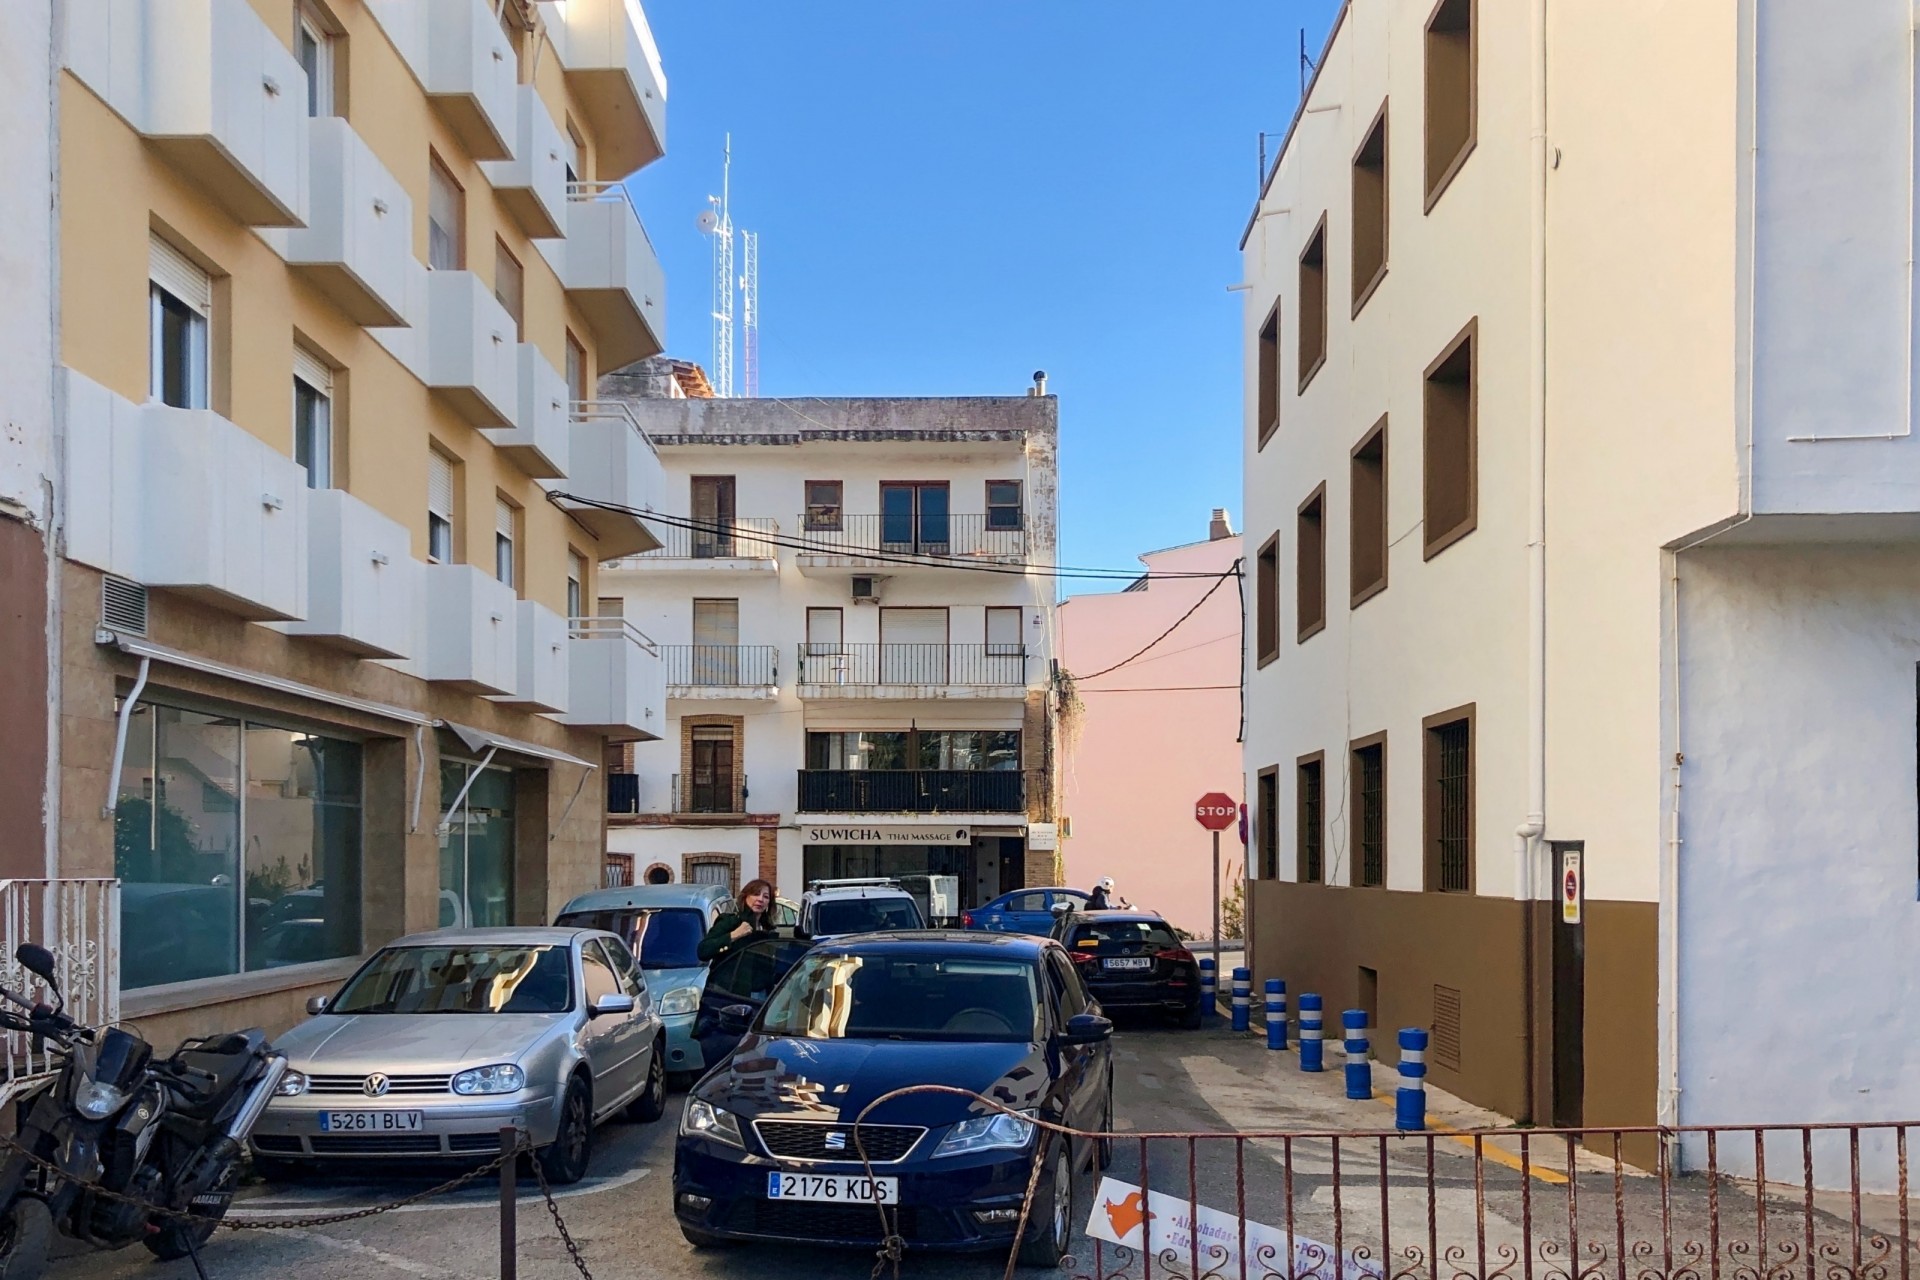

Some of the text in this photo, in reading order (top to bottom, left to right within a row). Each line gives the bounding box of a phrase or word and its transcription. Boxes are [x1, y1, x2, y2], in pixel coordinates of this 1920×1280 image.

[1197, 806, 1235, 816] STOP
[810, 829, 952, 841] SUWICHA THAI MASSAGE
[1109, 959, 1130, 967] 5657
[331, 1113, 418, 1130] 5261 BLV
[783, 1176, 888, 1200] 2176 KDS
[1175, 1215, 1233, 1242] Alohadas
